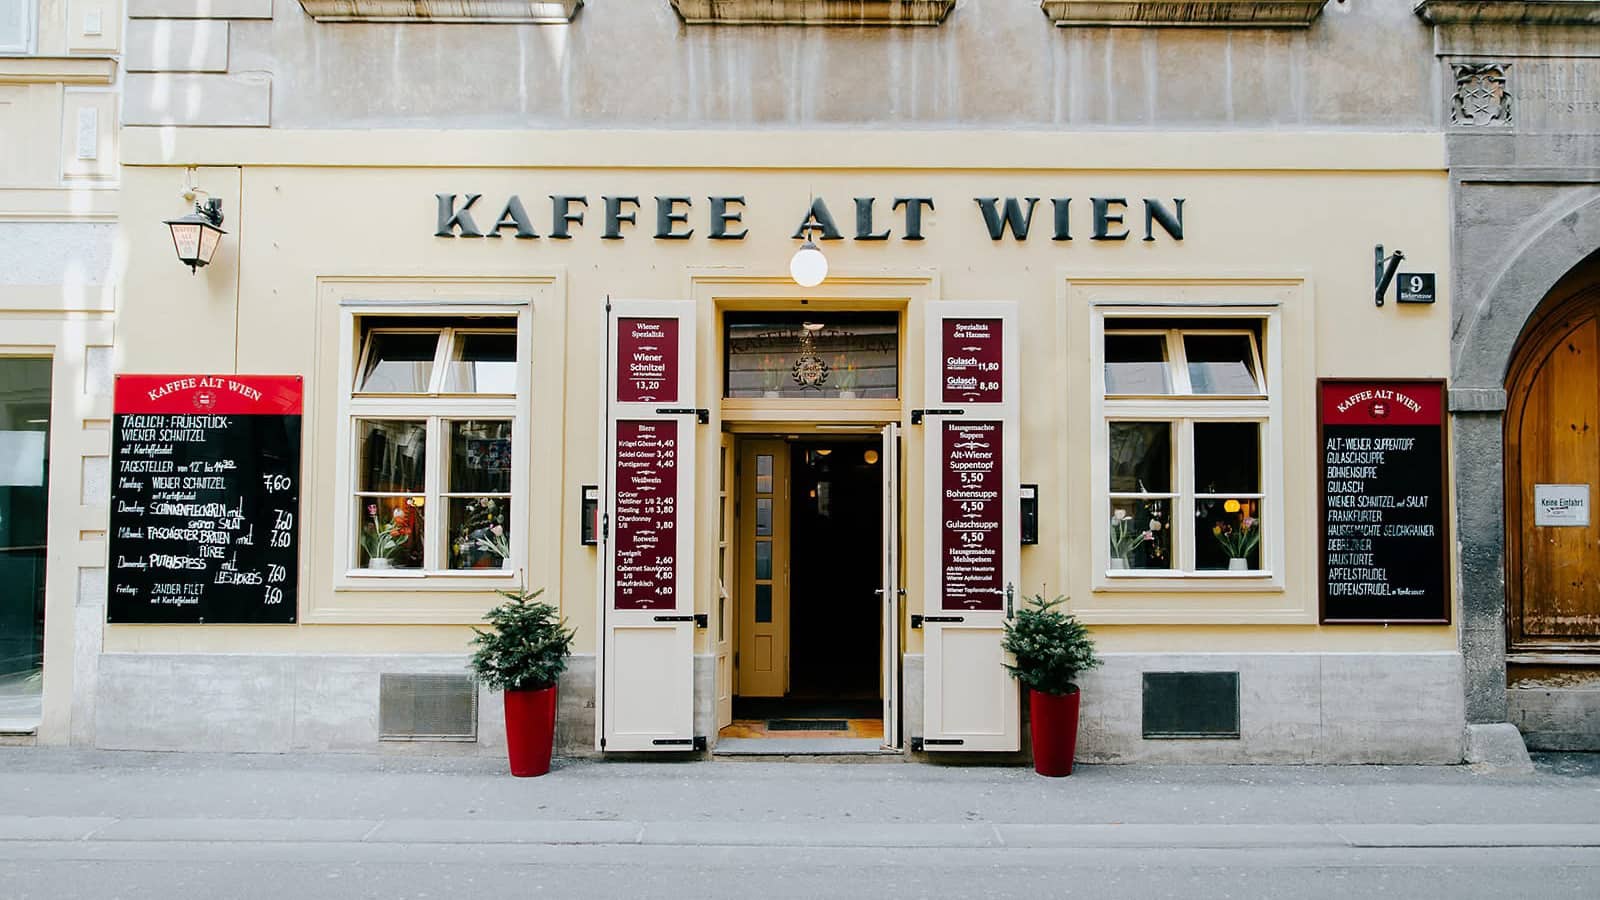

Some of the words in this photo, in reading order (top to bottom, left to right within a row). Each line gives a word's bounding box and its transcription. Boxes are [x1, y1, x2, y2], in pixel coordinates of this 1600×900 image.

[434, 193, 750, 240] KAFFEE
[791, 196, 935, 240] ALT
[973, 196, 1187, 241] WIEN
[1410, 275, 1423, 293] 9
[632, 330, 664, 339] Spezialität
[633, 353, 663, 361] Wiener
[630, 363, 665, 372] Schnitzel
[947, 357, 977, 365] Gulasch
[978, 362, 999, 372] 11,80
[148, 378, 197, 401] KAFFEE
[199, 377, 225, 388] ALT
[228, 380, 262, 401] WIEN
[636, 380, 660, 390] 13,20
[947, 376, 977, 386] Gulasch
[979, 382, 999, 391] 8,80
[1337, 390, 1373, 413] KAFFEE
[1374, 389, 1394, 400] ALT
[1396, 392, 1422, 413] WIEN
[948, 424, 995, 432] Hausgemachte
[121, 429, 156, 441] WIENER
[158, 429, 206, 442] SCHNITZEL
[960, 432, 984, 440] Suppen
[120, 444, 132, 454] mit
[656, 440, 674, 448] 4,40
[1326, 438, 1372, 450] ALT-WIENER
[1373, 438, 1416, 450] SUPPENTOPF
[656, 450, 674, 458] 3,40
[1326, 452, 1386, 464] GULASCHSUPPE
[120, 460, 174, 472] TAGESTELLER
[204, 461, 214, 472] bis
[656, 460, 674, 468] 4,40
[950, 461, 994, 470] Suppentopf
[960, 472, 984, 484] 5,50
[1327, 466, 1378, 479] BOHNENSUPPE
[152, 476, 180, 489] WIENER
[182, 476, 226, 490] SCHNITZEL
[263, 473, 291, 494] 7,60
[1328, 480, 1364, 493] GULASCH
[946, 490, 998, 498] Bohnensuppe
[656, 497, 674, 505] 2,40
[960, 502, 984, 512] 4,50
[1328, 496, 1356, 508] WIENER
[1357, 496, 1396, 508] SCHNITZEL
[1406, 495, 1429, 508] SALAT
[1541, 498, 1558, 507] Keine
[1559, 498, 1584, 507] Einfahrt
[226, 496, 246, 520] mit
[656, 506, 674, 514] 3,80
[1328, 510, 1383, 522] FRANKFURTER
[218, 518, 241, 530] SALAT
[656, 522, 674, 530] 3,80
[946, 520, 998, 529] Gulaschsuppe
[1328, 524, 1382, 536] HAUSGEMACHTE
[198, 530, 231, 544] BRATEN
[236, 524, 254, 545] mit
[270, 530, 291, 548] 7,60
[960, 532, 984, 544] 4,50
[1328, 538, 1372, 551] DEBREZINER
[200, 544, 226, 558] PÜREE
[656, 556, 673, 565] 2,60
[952, 556, 992, 564] Mehlspeisen
[1328, 553, 1375, 566] HAUSTORTE
[220, 551, 238, 571] mit
[267, 563, 286, 583] 7,60
[643, 566, 672, 574] Sauvignon
[655, 572, 673, 580] 4,80
[1328, 568, 1388, 581] APFELSTRUDEL
[151, 583, 182, 594] ZANDER
[183, 583, 204, 594] FILET
[264, 585, 283, 604] 7,60
[655, 587, 672, 596] 4,80
[1328, 582, 1392, 596] TOPFENSTRUDEL
